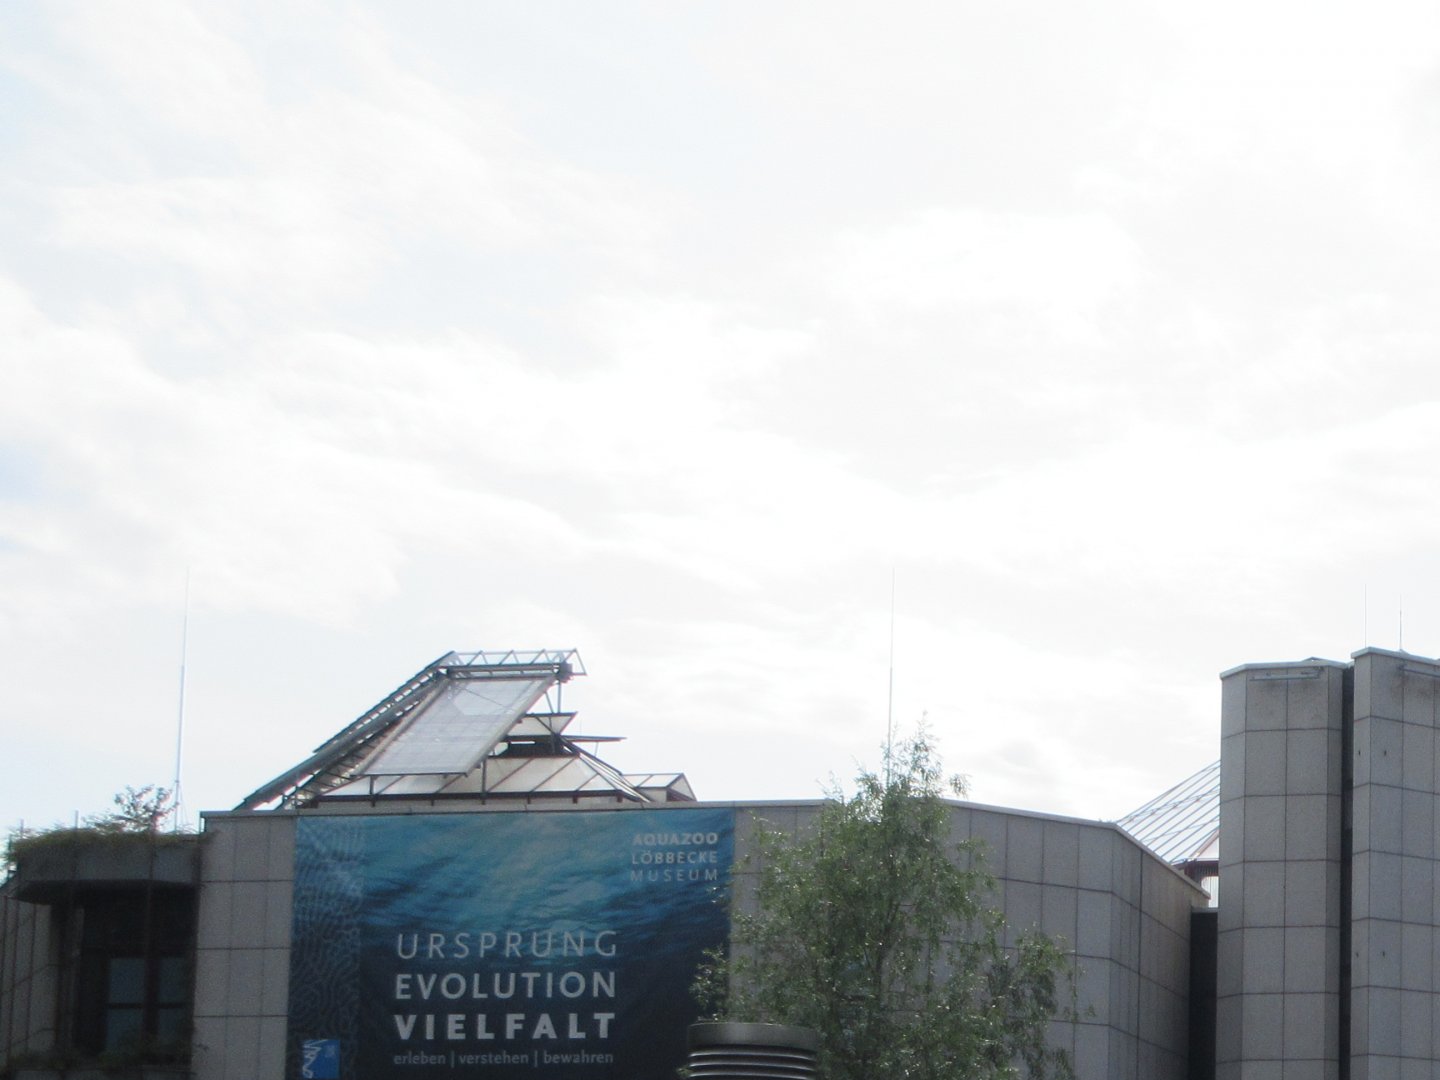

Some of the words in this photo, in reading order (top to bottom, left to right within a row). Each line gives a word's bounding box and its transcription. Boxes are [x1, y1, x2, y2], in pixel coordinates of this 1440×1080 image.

[633, 832, 718, 847] AQUAZOO
[631, 850, 718, 865] LÖBBECKE
[631, 869, 718, 882] MUSEUM
[397, 930, 617, 960] URSPRUNG
[395, 971, 615, 1000] EVOLUTION
[394, 1012, 615, 1040] VIELFALT
[393, 1051, 446, 1065] erleben
[459, 1050, 529, 1065] verstehen
[543, 1049, 614, 1064] bewahren
